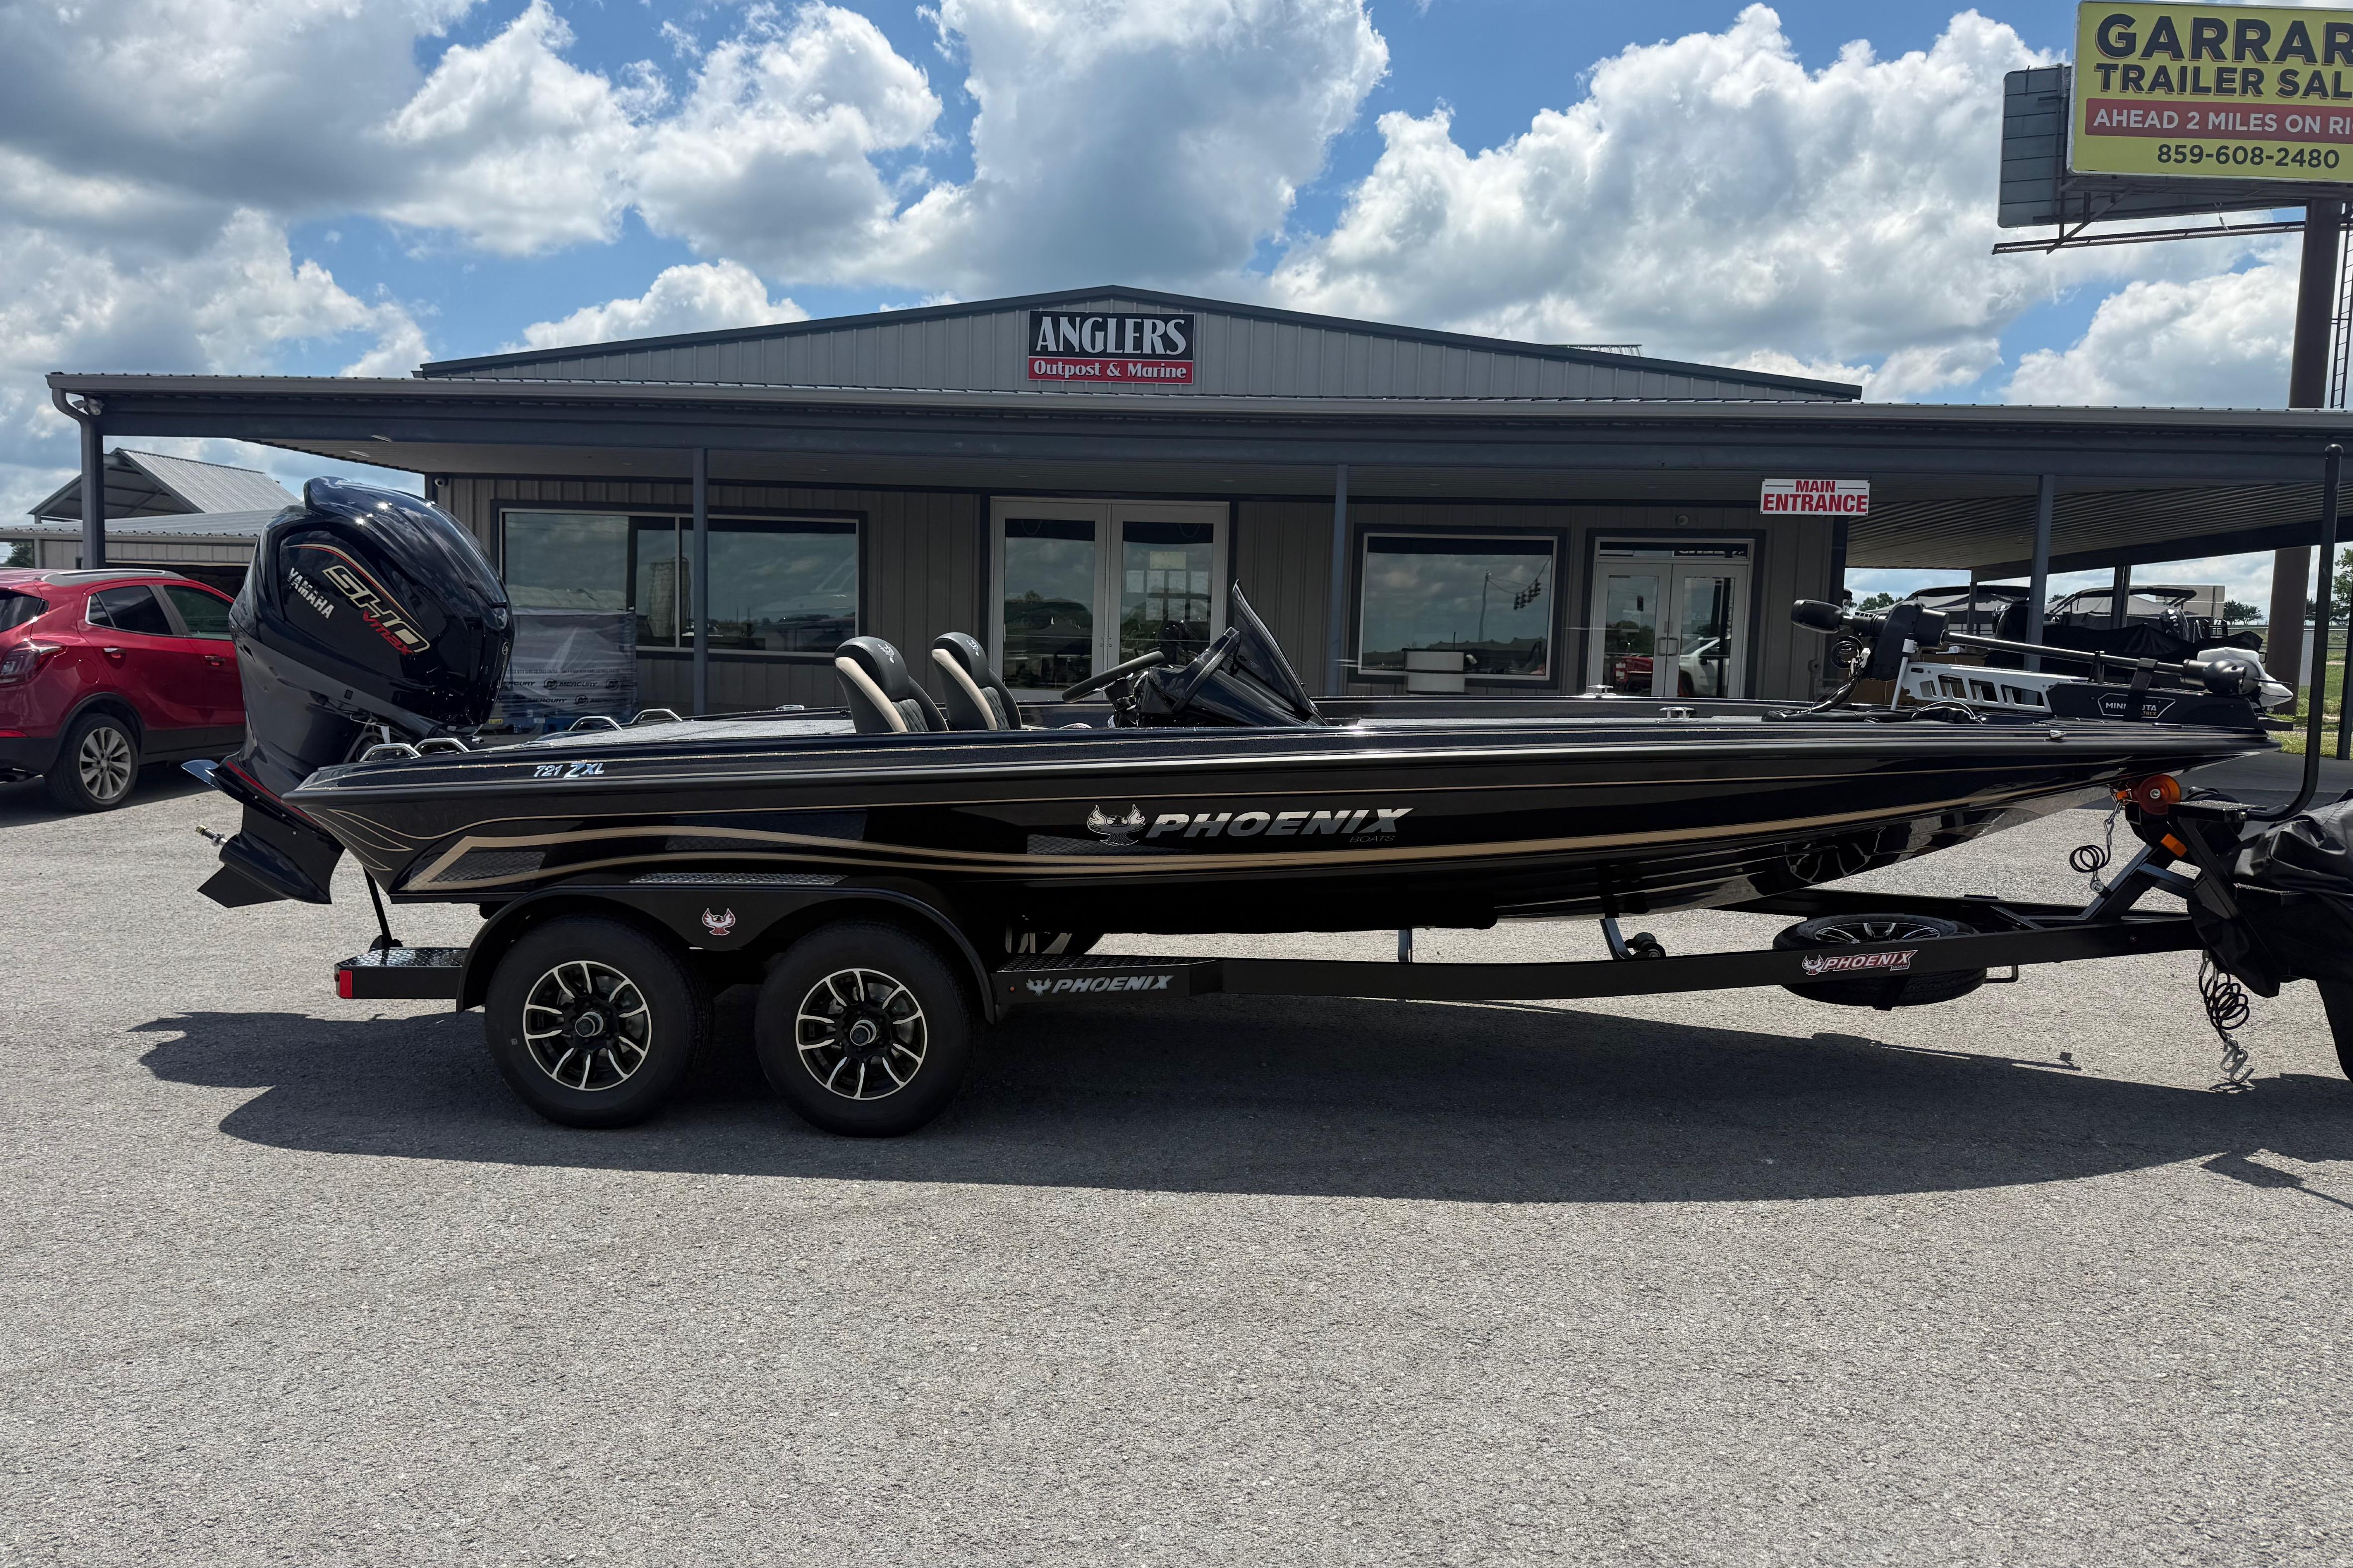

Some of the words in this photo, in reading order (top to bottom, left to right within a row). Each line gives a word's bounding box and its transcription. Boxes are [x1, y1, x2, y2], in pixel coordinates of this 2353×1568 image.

[2094, 63, 2264, 96] TRAILER
[2276, 69, 2353, 100] SAL
[2093, 108, 2179, 129] AHEAD
[2186, 111, 2200, 130] 2
[2208, 112, 2277, 133] MILES
[2285, 114, 2321, 133] ON
[2329, 116, 2353, 135] RI
[2157, 144, 2340, 169] 859-608-2480
[1035, 316, 1186, 355] ANGLERS
[1034, 361, 1101, 379] Outpost
[1107, 363, 1122, 377] &
[1127, 363, 1187, 379] Marine
[1795, 480, 1836, 493] MAIN
[1763, 493, 1868, 512] ENTRANCE
[287, 567, 334, 619] YAMAHA
[533, 765, 563, 778] 721
[1145, 808, 1414, 838] PHOENIX
[1823, 951, 1914, 971] PHOENIX
[1051, 975, 1174, 993] PHOENIX
